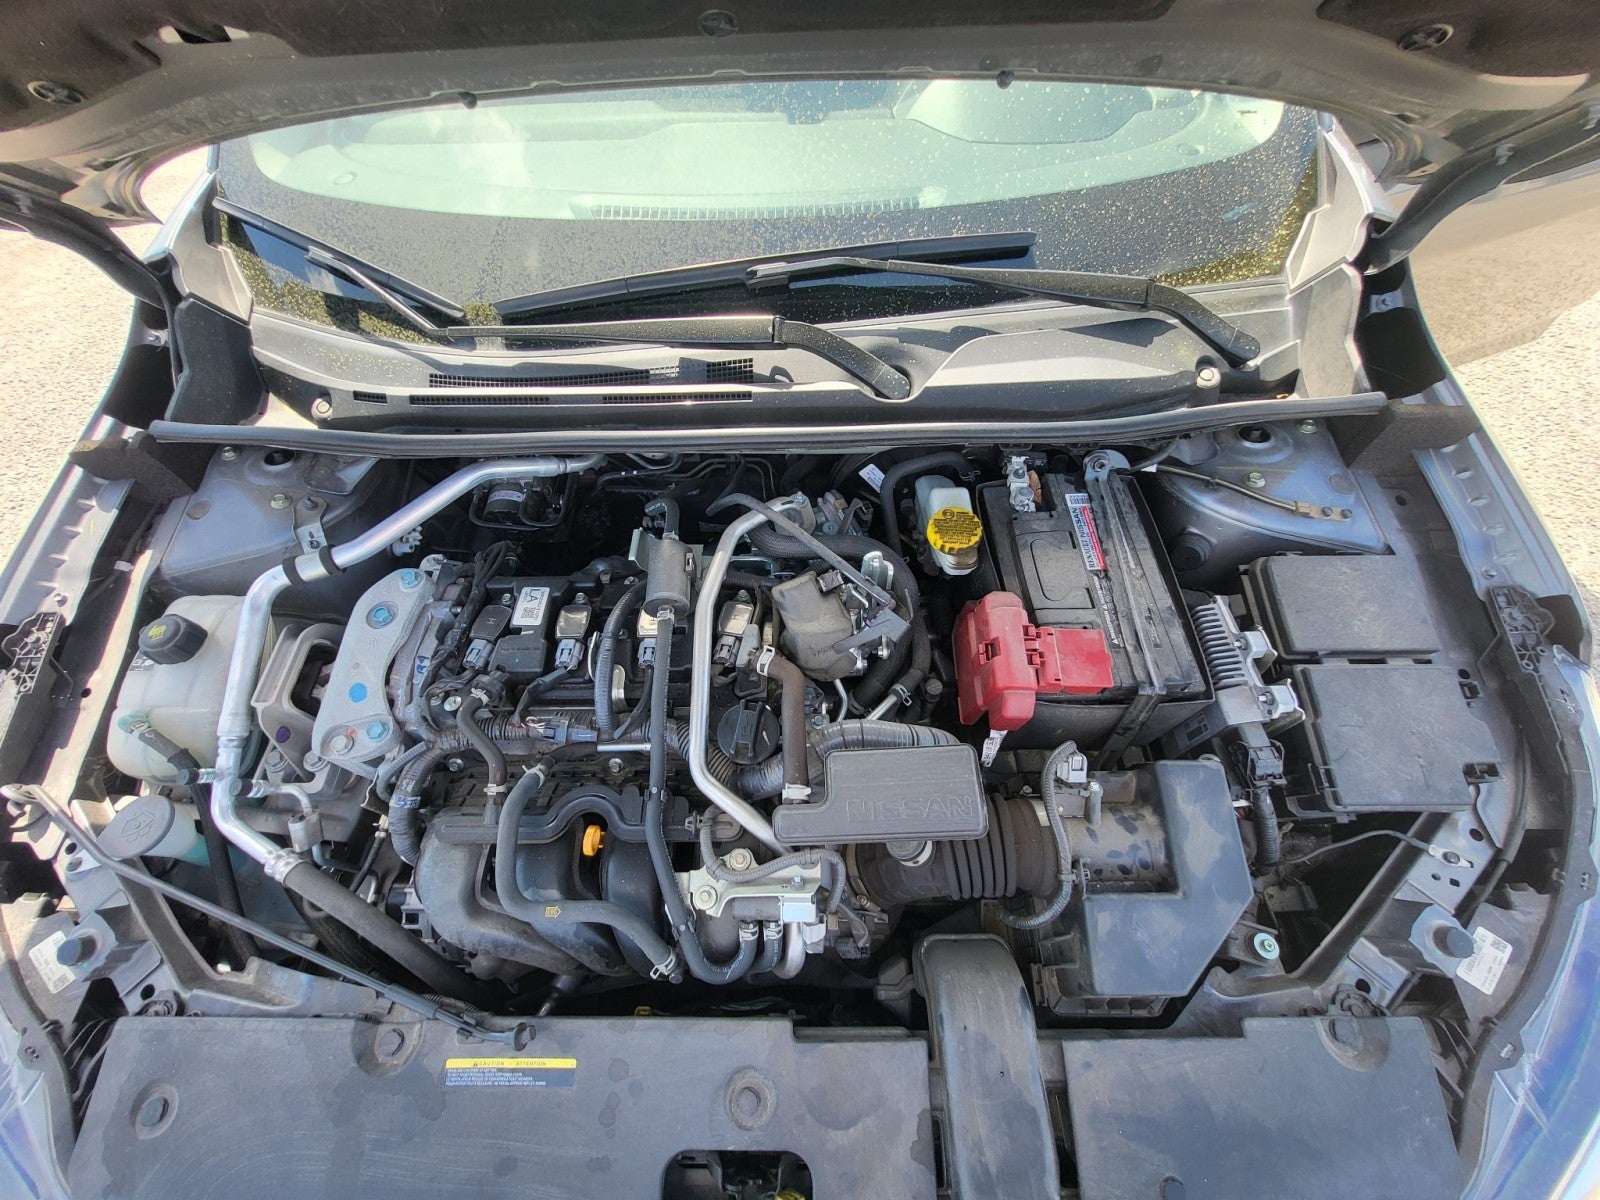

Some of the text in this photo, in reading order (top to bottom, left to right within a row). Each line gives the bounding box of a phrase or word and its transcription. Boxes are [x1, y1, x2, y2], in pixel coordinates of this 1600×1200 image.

[1071, 507, 1086, 538] NISSAN
[527, 589, 541, 603] LA
[846, 795, 974, 823] NISSAN
